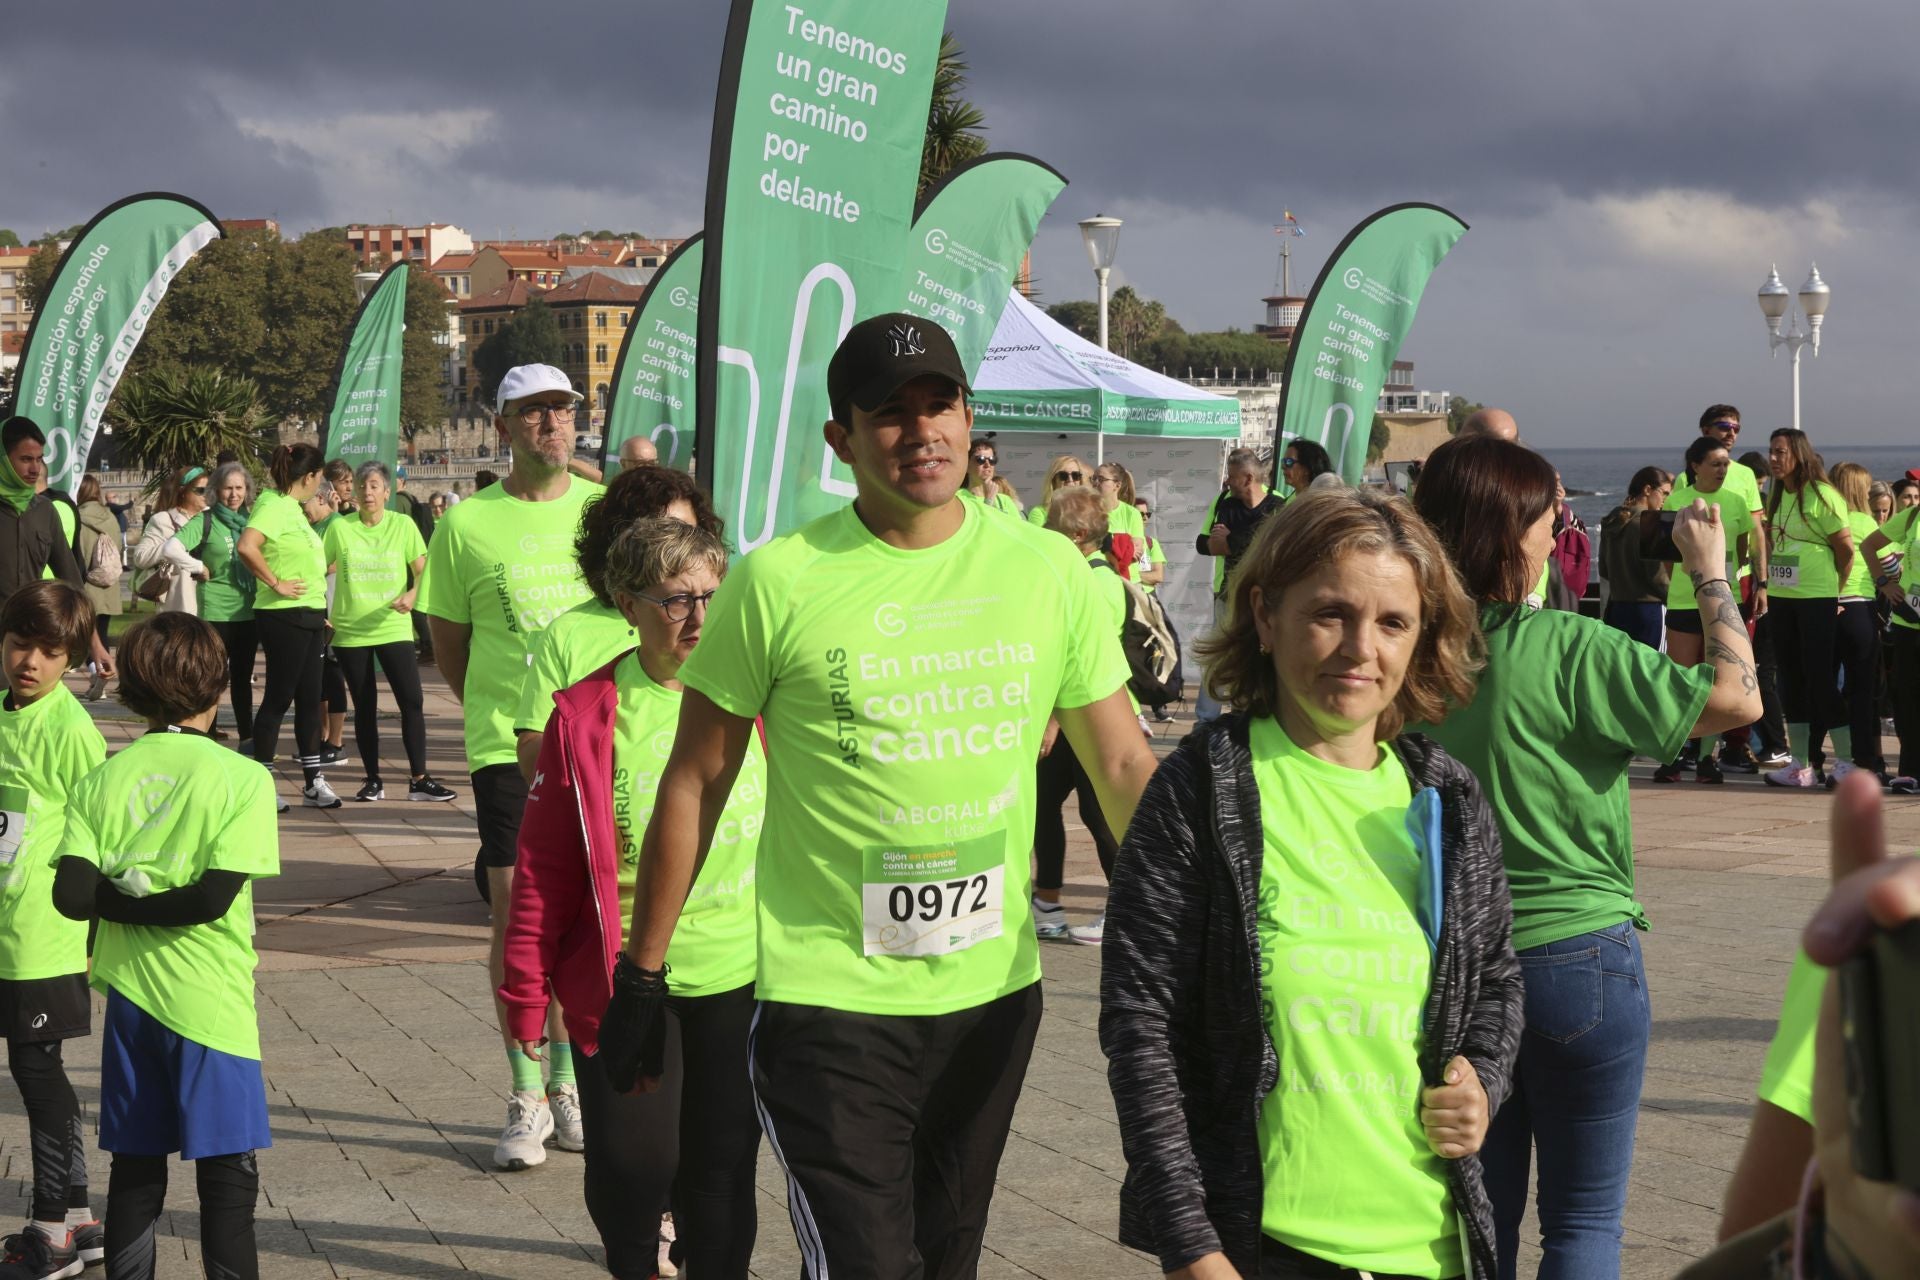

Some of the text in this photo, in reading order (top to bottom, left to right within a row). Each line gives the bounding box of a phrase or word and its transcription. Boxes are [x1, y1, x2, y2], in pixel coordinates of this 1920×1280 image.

[785, 4, 907, 75] Tenemos
[775, 50, 878, 106] un gran
[769, 92, 868, 143] camino
[763, 132, 809, 164] por
[760, 169, 861, 223] delante
[908, 290, 966, 326] un gran
[917, 270, 986, 315] Tenemos
[34, 244, 110, 407] asociación española
[655, 319, 697, 348] Tenem
[1328, 320, 1375, 350] un gran
[1336, 303, 1391, 342] Tenemos
[52, 283, 108, 412] contra el cáncer
[647, 337, 696, 366] un gran
[986, 344, 1041, 353] spañola
[1317, 351, 1342, 366] por
[1323, 336, 1369, 363] camino
[66, 332, 105, 420] en Asturias
[636, 369, 662, 384] por
[642, 353, 689, 378] camino
[1314, 366, 1364, 392] delante
[633, 384, 683, 410] delante
[1001, 403, 1020, 417] EL
[1024, 401, 1092, 418] CÁNCER
[511, 563, 536, 580] En
[1770, 566, 1793, 578] 0199
[494, 562, 519, 633] ASTURIAS
[514, 582, 591, 605] contra
[859, 639, 1036, 681] En marcha
[826, 647, 862, 770] ASTURIAS
[863, 672, 1031, 721] contra el
[871, 716, 1031, 763] cáncer
[739, 773, 764, 801] el
[615, 767, 639, 866] ASTURIAS
[878, 800, 984, 826] LABORAL
[944, 822, 986, 839] kutxa
[882, 852, 907, 862] Gijón
[882, 859, 957, 870] contra el cáncer
[888, 874, 988, 923] 0972
[1292, 897, 1345, 930] En
[1258, 882, 1281, 1030] STURIAS
[1288, 983, 1419, 1041] cánc
[1291, 1068, 1412, 1098] LABORAL
